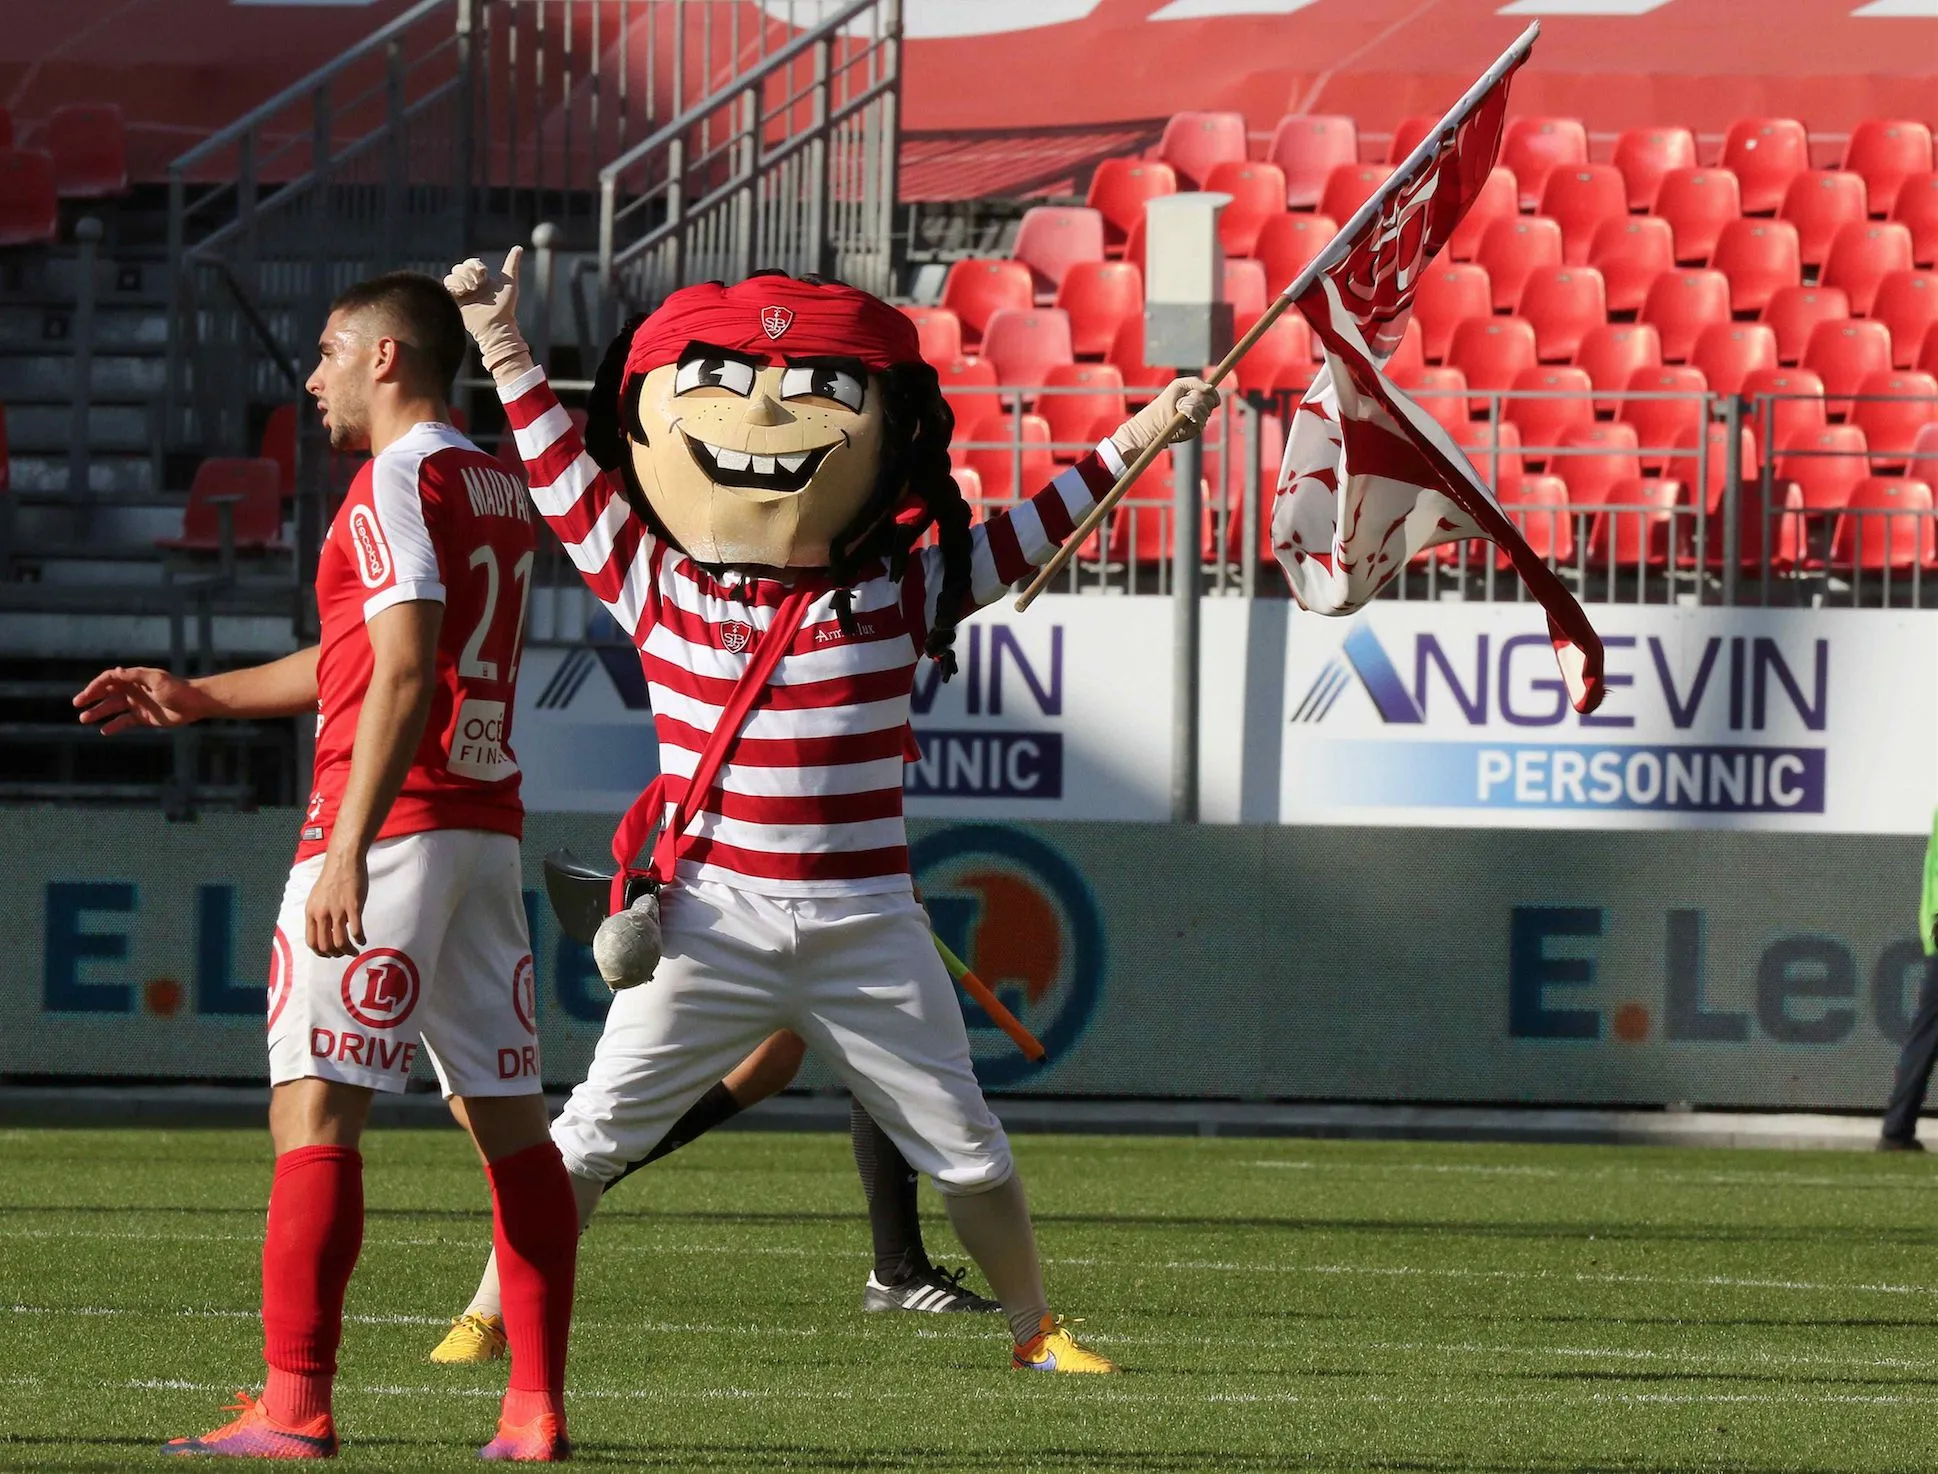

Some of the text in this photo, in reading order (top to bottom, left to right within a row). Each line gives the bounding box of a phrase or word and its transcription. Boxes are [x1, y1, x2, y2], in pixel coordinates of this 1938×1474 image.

[458, 544, 535, 684] 21
[1476, 750, 1806, 806] PERSONNIC
[310, 1027, 418, 1073] DRIVE
